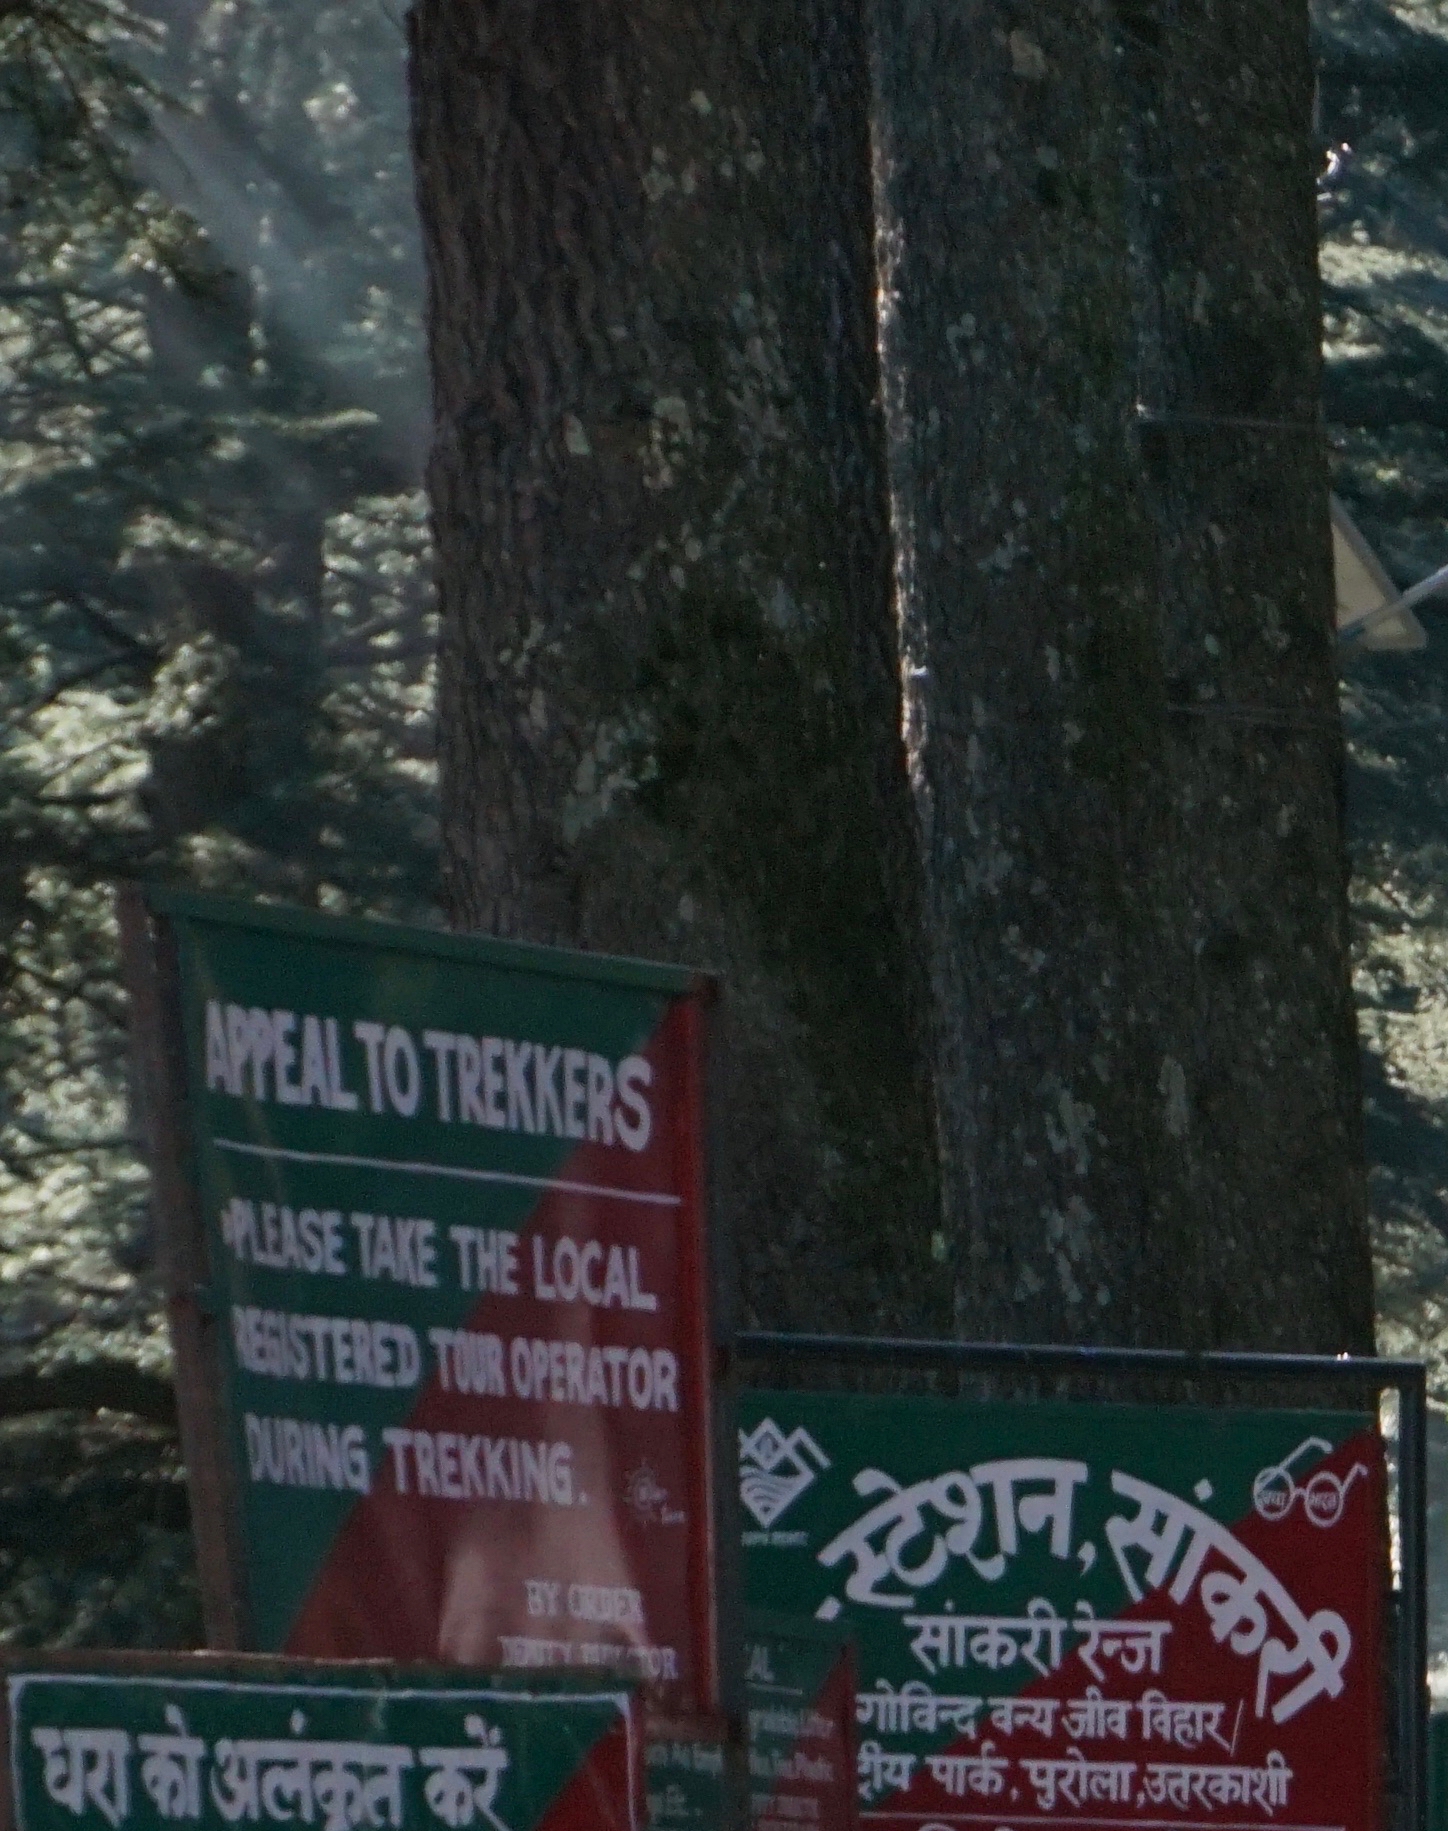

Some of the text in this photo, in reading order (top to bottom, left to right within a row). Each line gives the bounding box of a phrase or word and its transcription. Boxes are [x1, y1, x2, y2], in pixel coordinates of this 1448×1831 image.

[205, 998, 653, 1152] APPEAL TO TREKKERS
[230, 1196, 657, 1312] PLEASE TAKE THE LOCAL
[231, 1302, 678, 1411] REGISTERED TOUR OPERATOR
[243, 1412, 370, 1494] DURING
[902, 1597, 1173, 1682] सांकरी रेन्ज
[1105, 1470, 1353, 1726] सांकरी
[137, 1703, 205, 1820] को
[855, 1678, 984, 1740] गोविन्द
[986, 1696, 1061, 1737] वन्य
[1062, 1684, 1134, 1740] जीव
